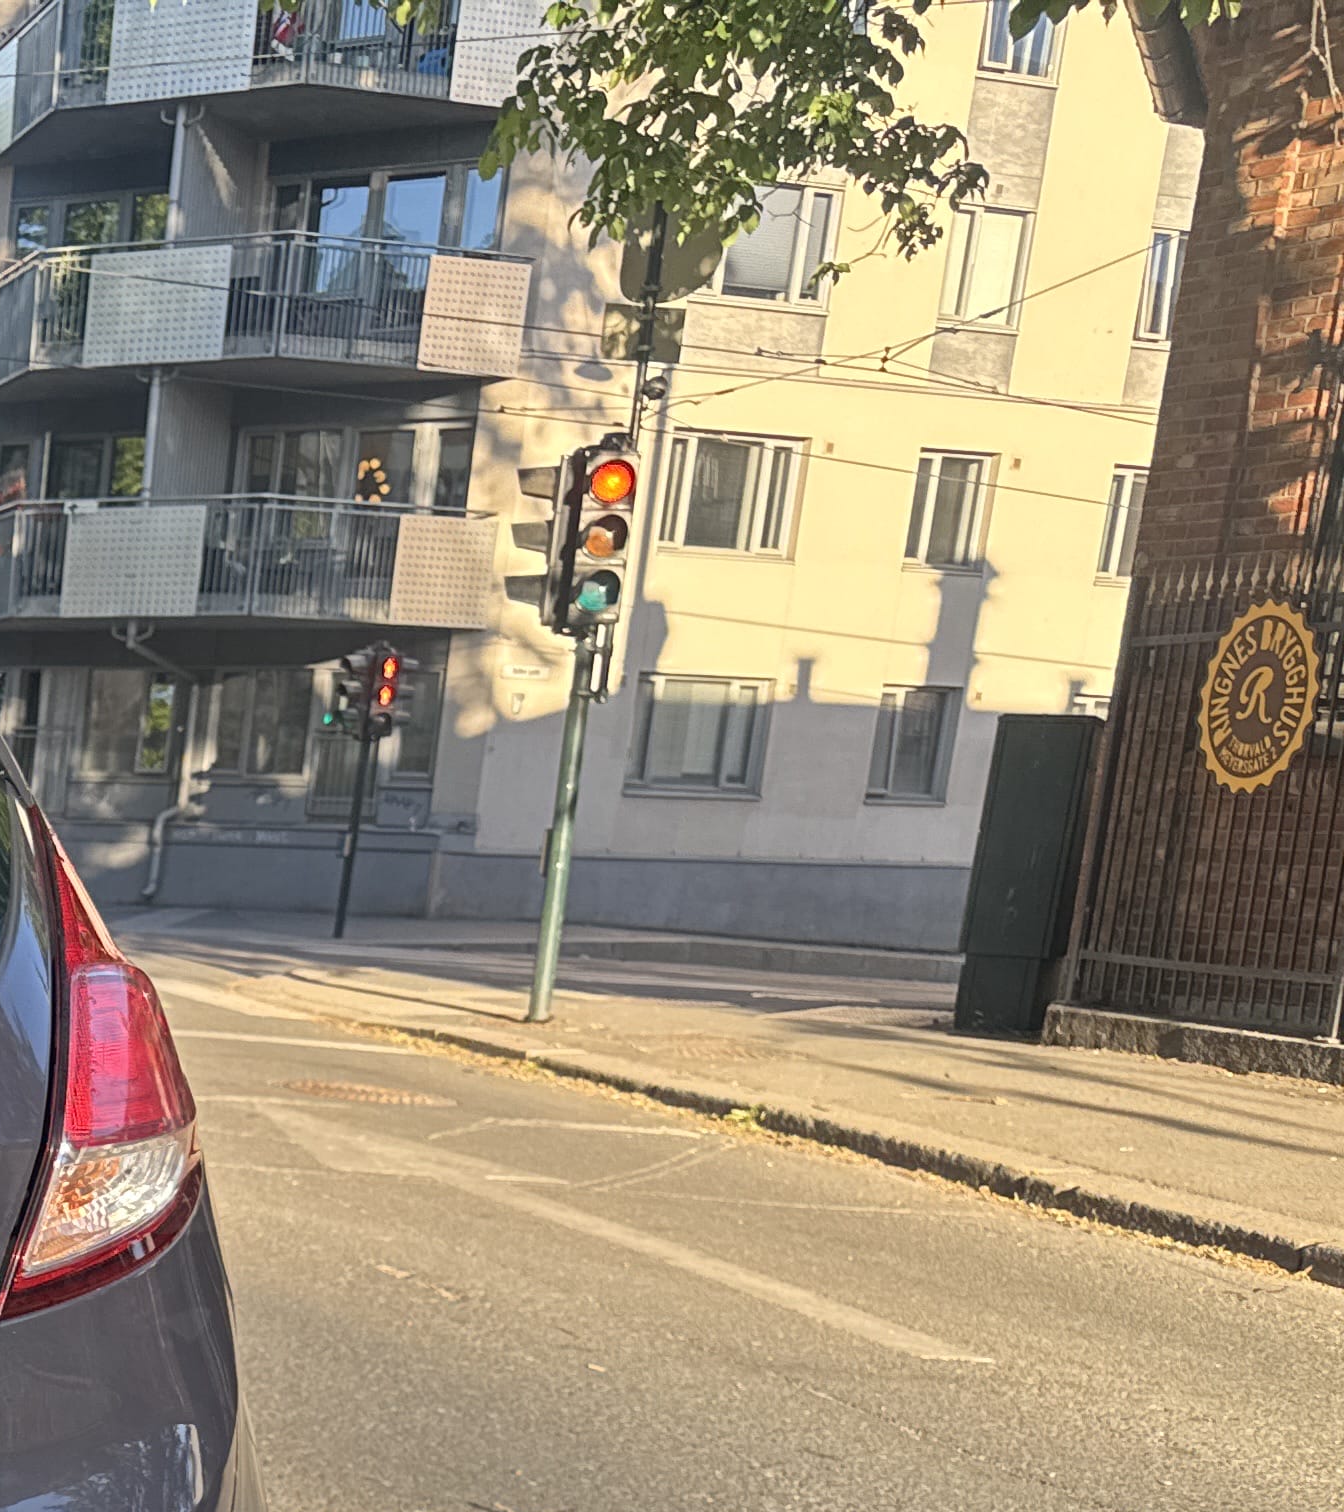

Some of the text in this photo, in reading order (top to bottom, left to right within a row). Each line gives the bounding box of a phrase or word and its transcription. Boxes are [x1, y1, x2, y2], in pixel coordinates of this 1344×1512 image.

[1209, 618, 1307, 747] RINGNES BRYGGHUS
[1235, 665, 1275, 724] R
